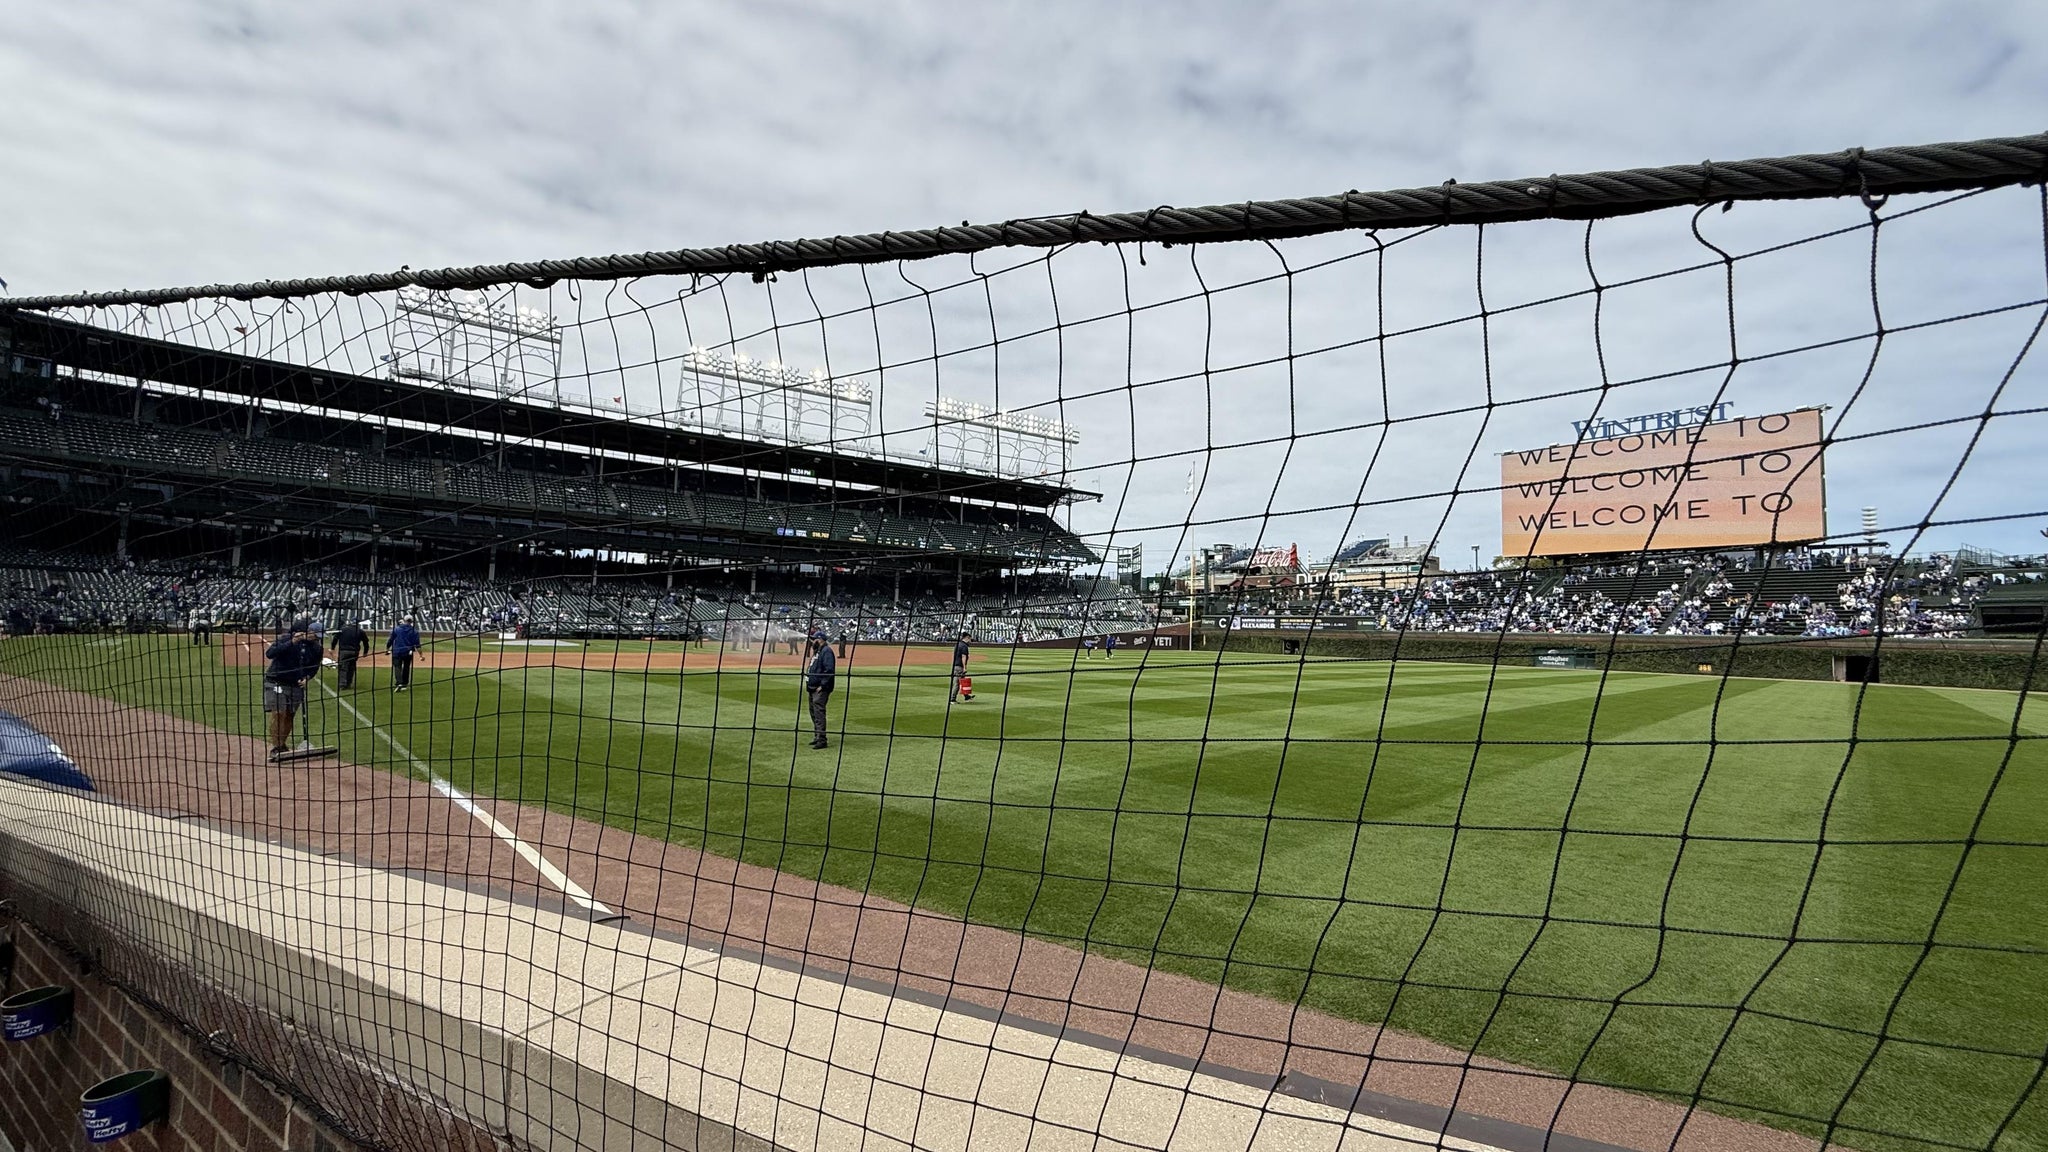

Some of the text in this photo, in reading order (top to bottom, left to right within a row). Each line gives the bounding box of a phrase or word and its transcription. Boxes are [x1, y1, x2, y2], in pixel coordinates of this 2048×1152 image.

[1519, 413, 1790, 466] WELCOME TO
[1571, 401, 1734, 441] WINTRUST
[1519, 452, 1791, 499] WELCOME TO
[1519, 492, 1793, 532] WELCOME TO
[1154, 636, 1172, 647] YETI
[1538, 655, 1569, 663] Gallagher
